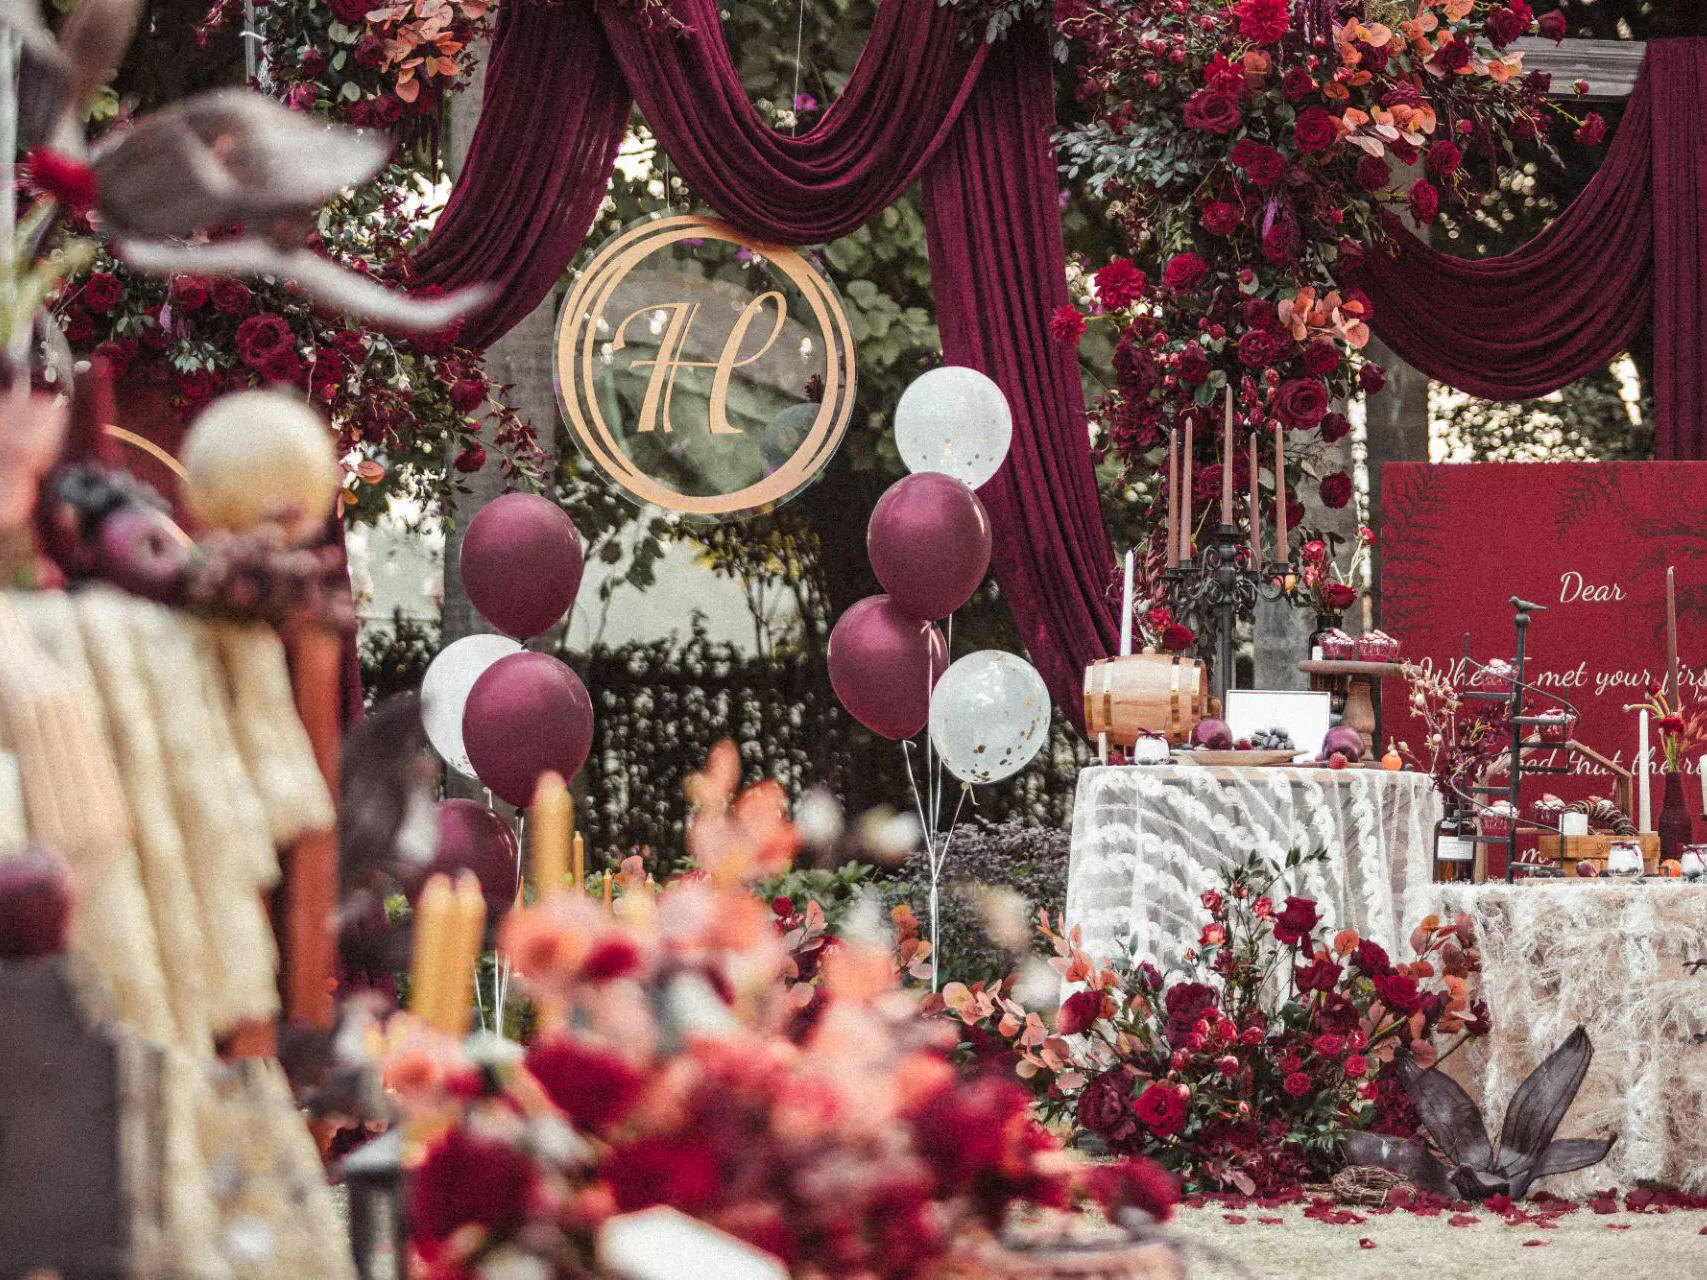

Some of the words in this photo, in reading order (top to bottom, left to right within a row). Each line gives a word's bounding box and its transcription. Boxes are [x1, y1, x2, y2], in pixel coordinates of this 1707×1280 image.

[1560, 571, 1628, 603] Dear
[1420, 656, 1484, 689] Whe
[1537, 661, 1588, 687] met
[1595, 668, 1652, 696] your
